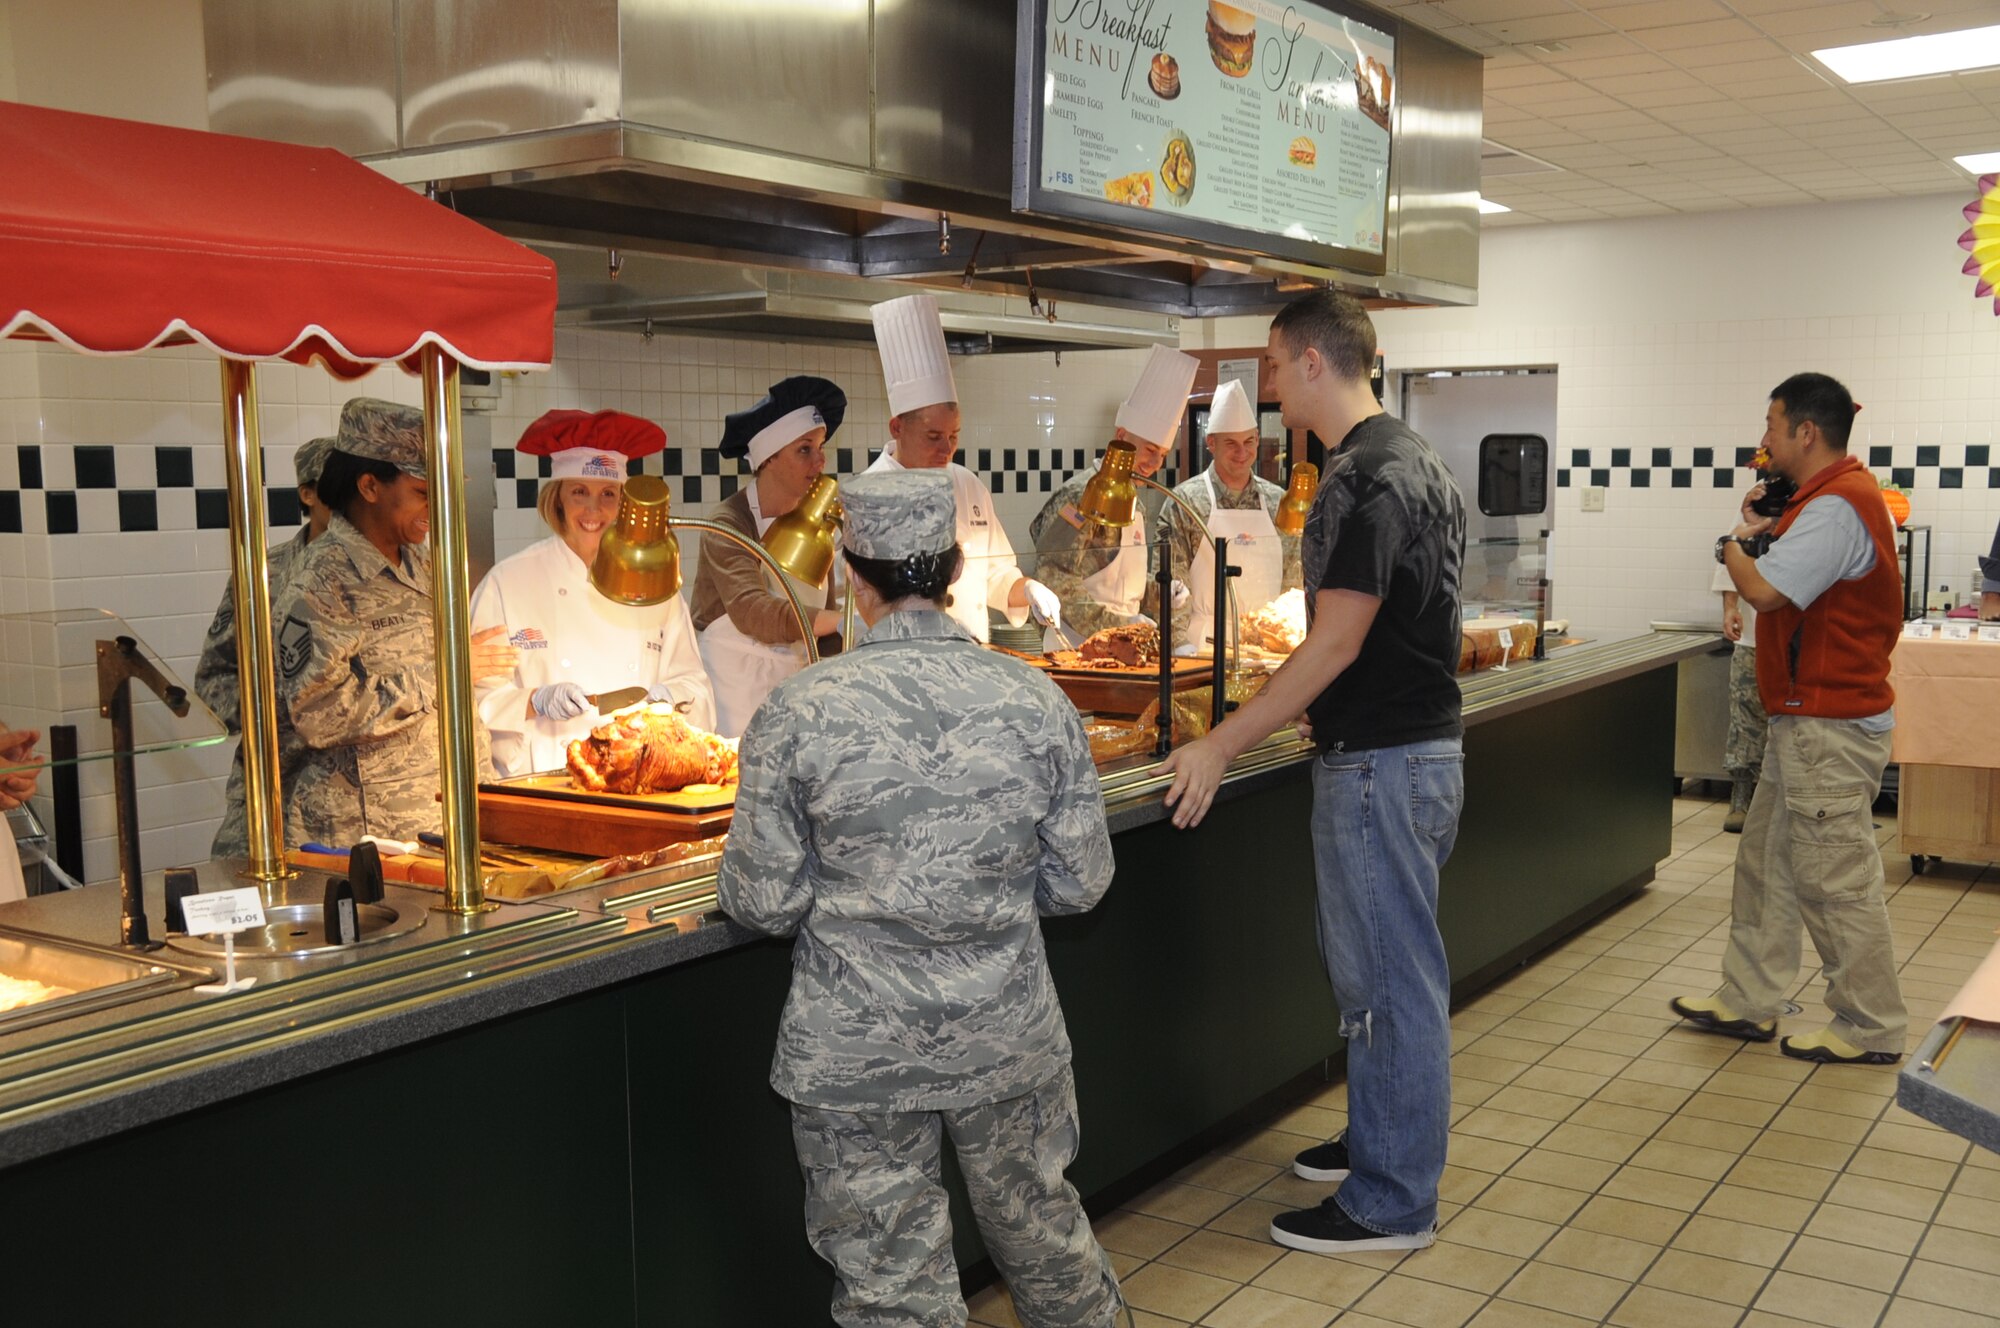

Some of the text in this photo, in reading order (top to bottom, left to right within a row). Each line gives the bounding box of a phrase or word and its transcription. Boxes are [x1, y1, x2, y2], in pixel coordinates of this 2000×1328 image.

[1052, 27, 1120, 72] MENU
[1069, 74, 1087, 88] EGGS
[1220, 79, 1235, 91] FROM
[1052, 88, 1104, 111] CRAMBLED EGGS
[1131, 91, 1161, 109] PANCAKES
[1049, 103, 1077, 121] OMELETS
[1131, 108, 1175, 129] FRENCH TOAST
[1277, 100, 1326, 134] MENU
[1073, 124, 1104, 142] TOPPINGS
[1056, 171, 1074, 185] FSS
